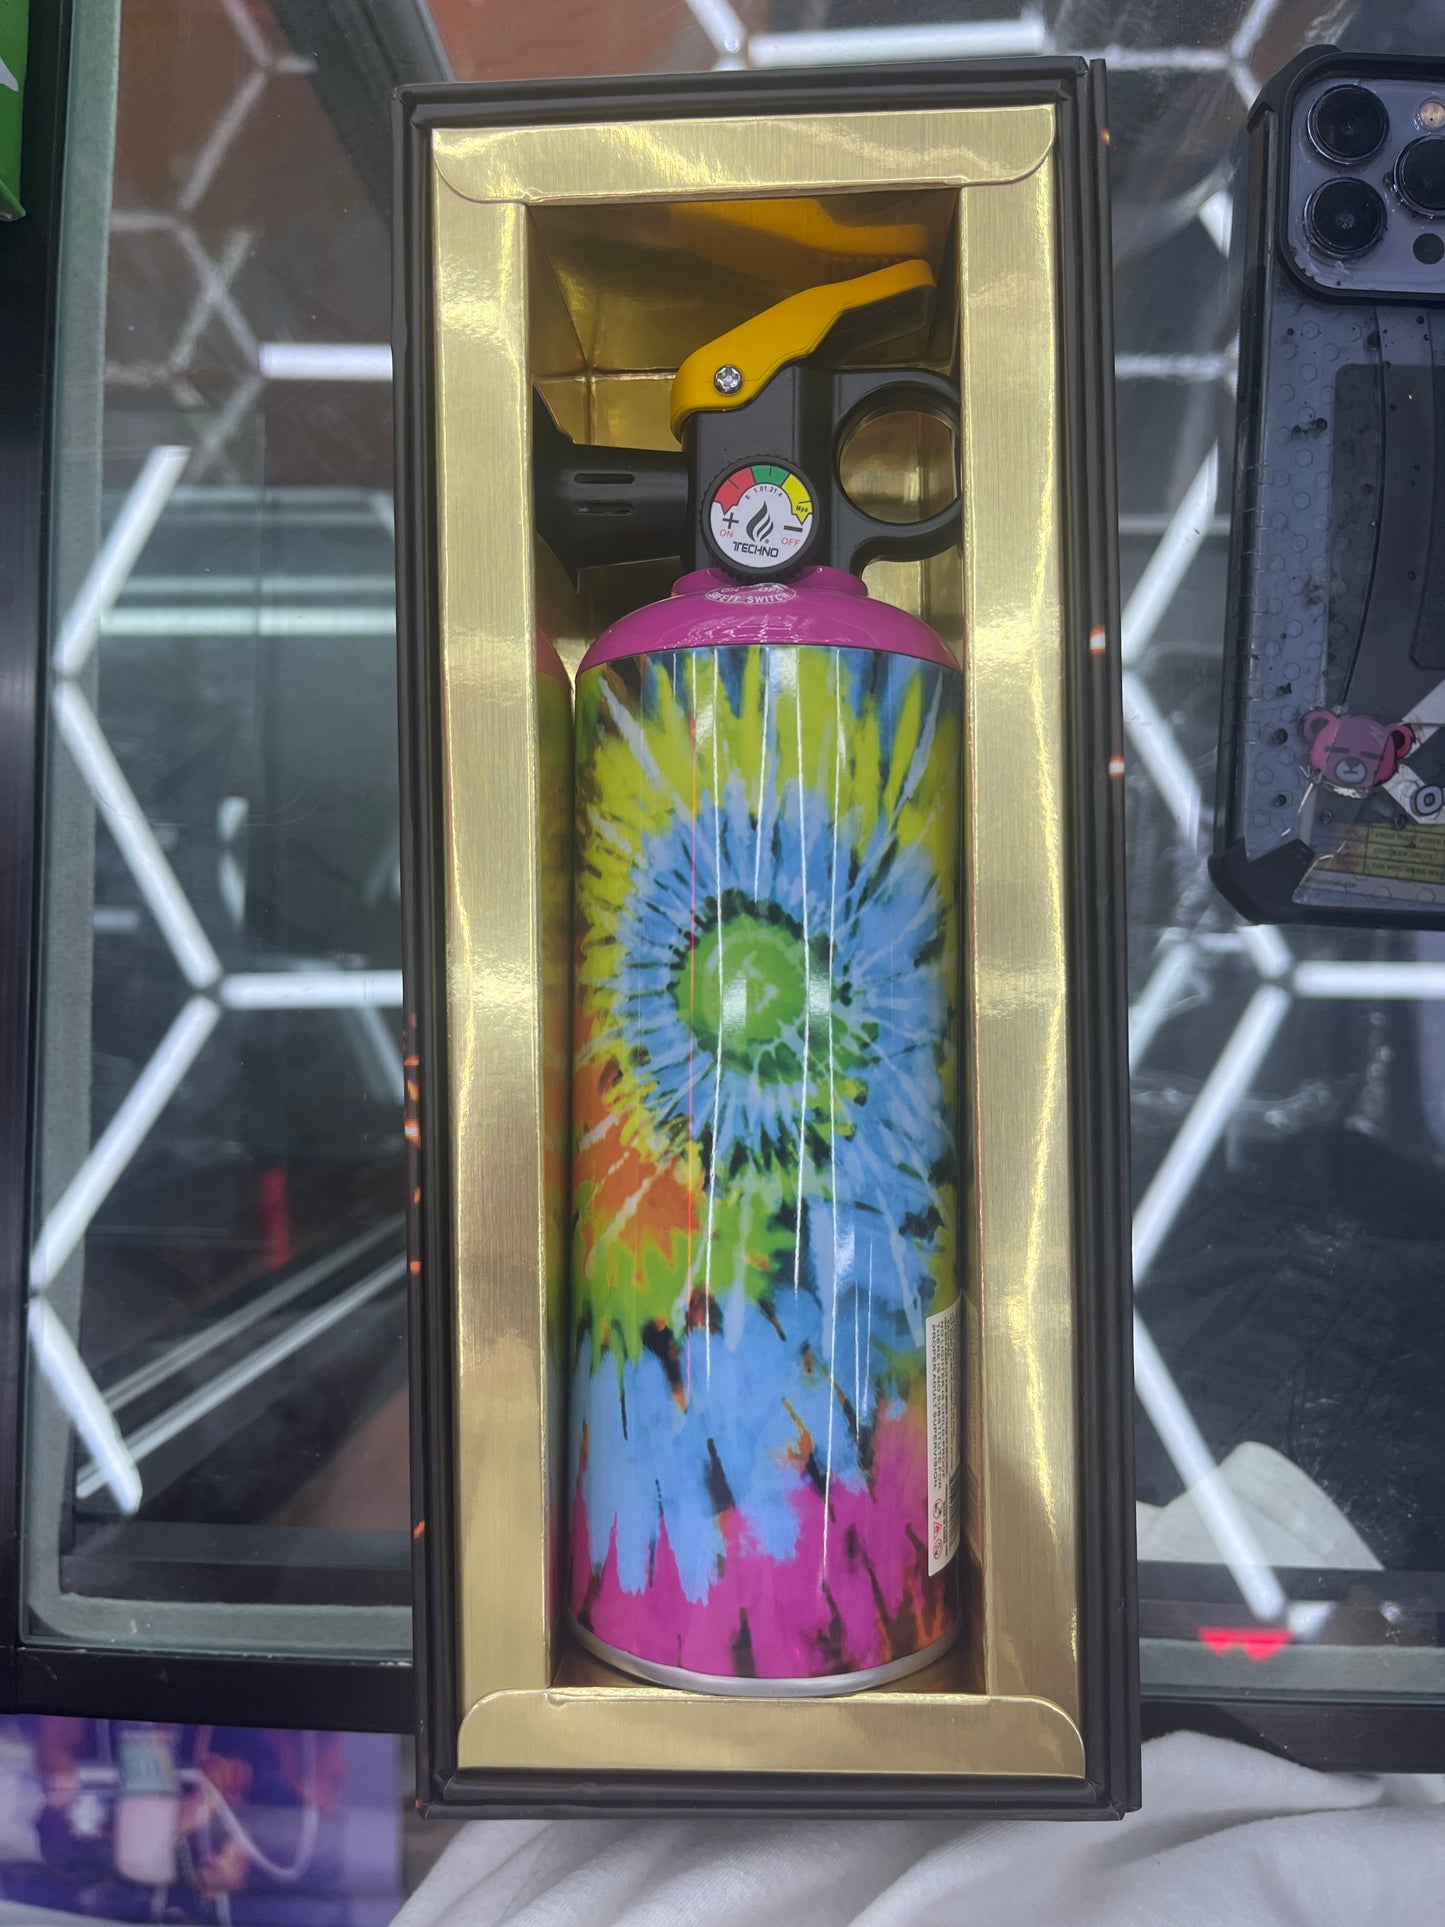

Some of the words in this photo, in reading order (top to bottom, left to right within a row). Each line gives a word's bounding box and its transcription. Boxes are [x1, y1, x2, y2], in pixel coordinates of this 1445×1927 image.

[719, 529, 734, 538] ON
[781, 537, 801, 547] OFF
[732, 541, 779, 558] TECHNO
[747, 592, 791, 604] SWITCH
